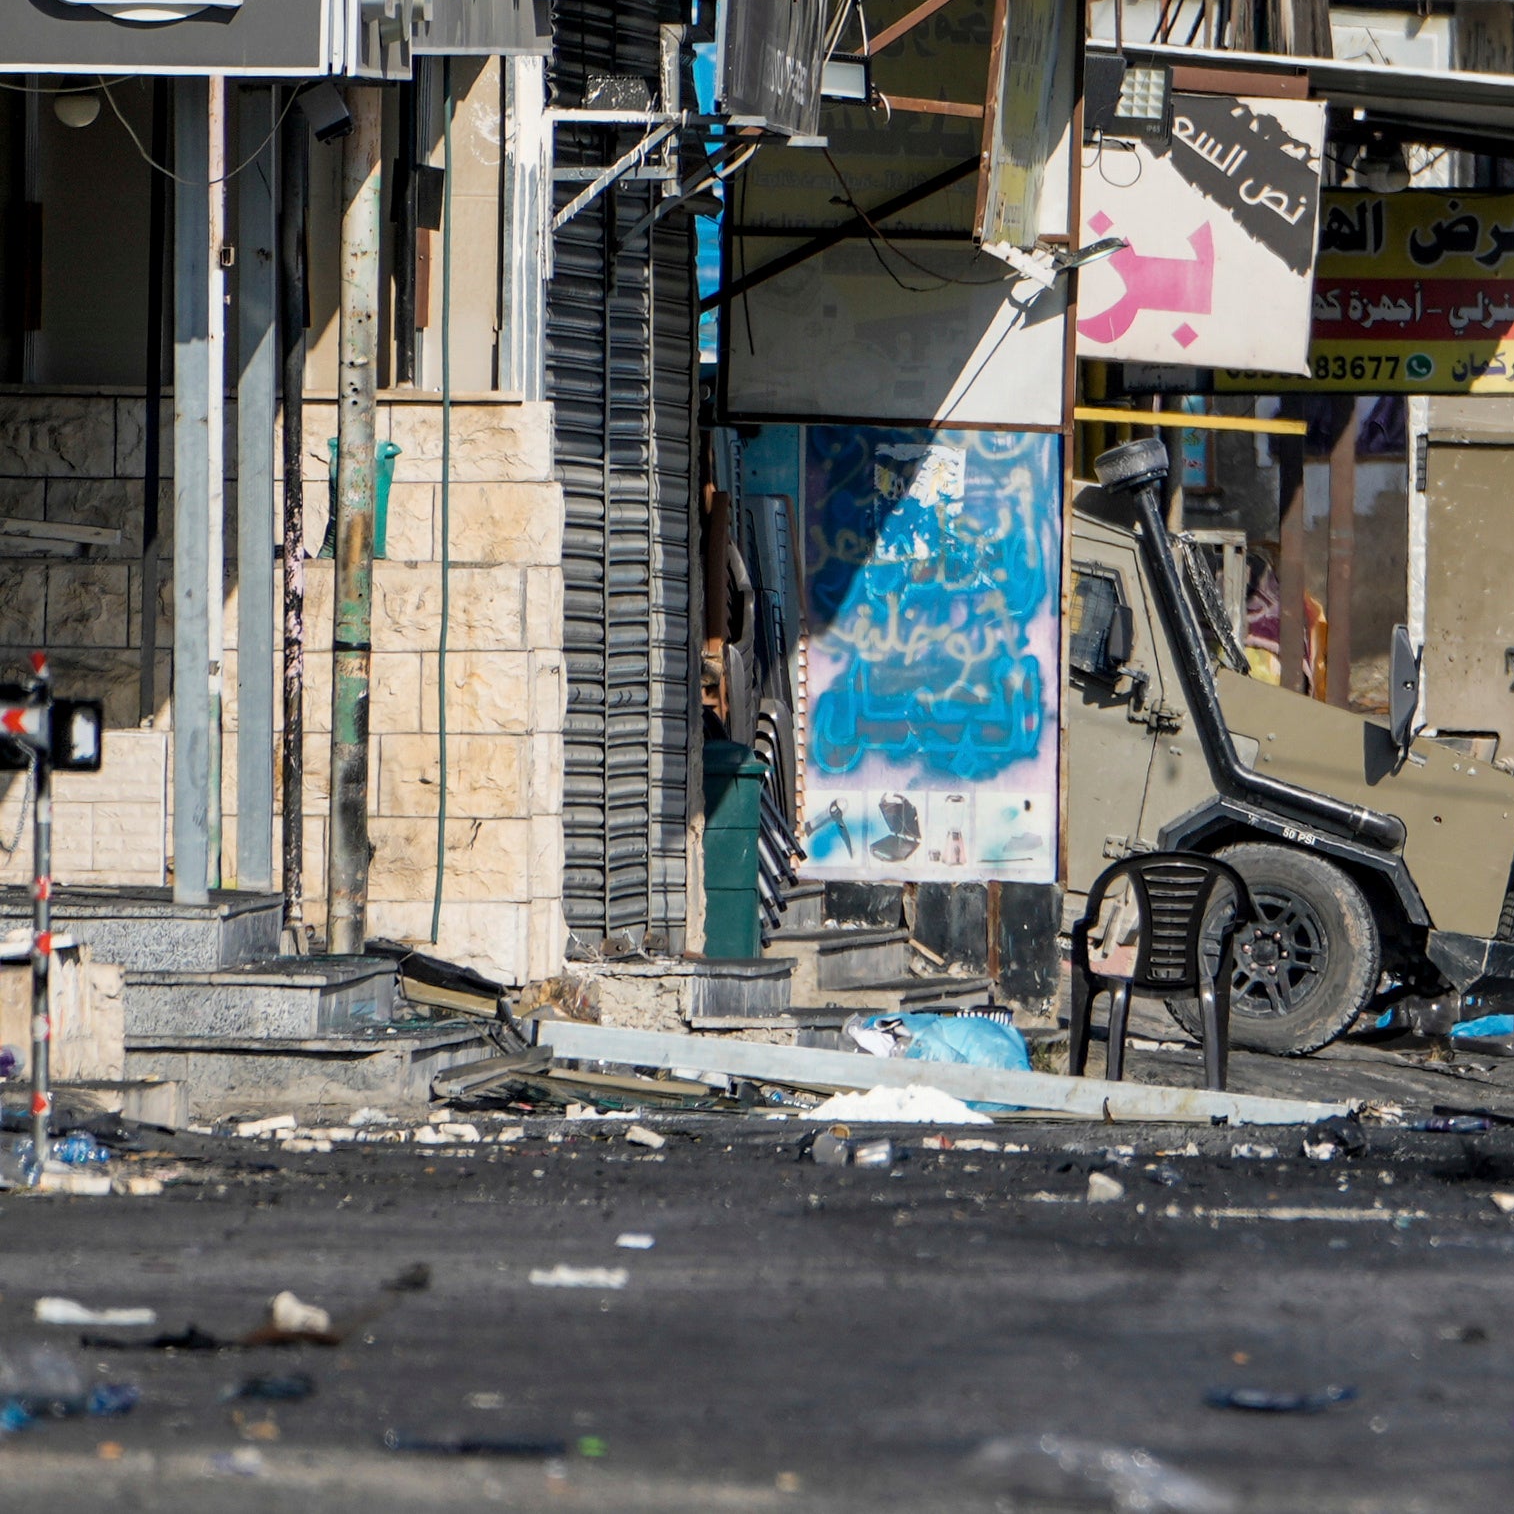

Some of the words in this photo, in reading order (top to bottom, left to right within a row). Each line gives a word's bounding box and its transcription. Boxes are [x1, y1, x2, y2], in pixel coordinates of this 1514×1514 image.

[1238, 178, 1308, 226] نص
[1347, 283, 1426, 328] أجهزة
[1282, 826, 1296, 840] 50
[1297, 832, 1317, 846] PSI
